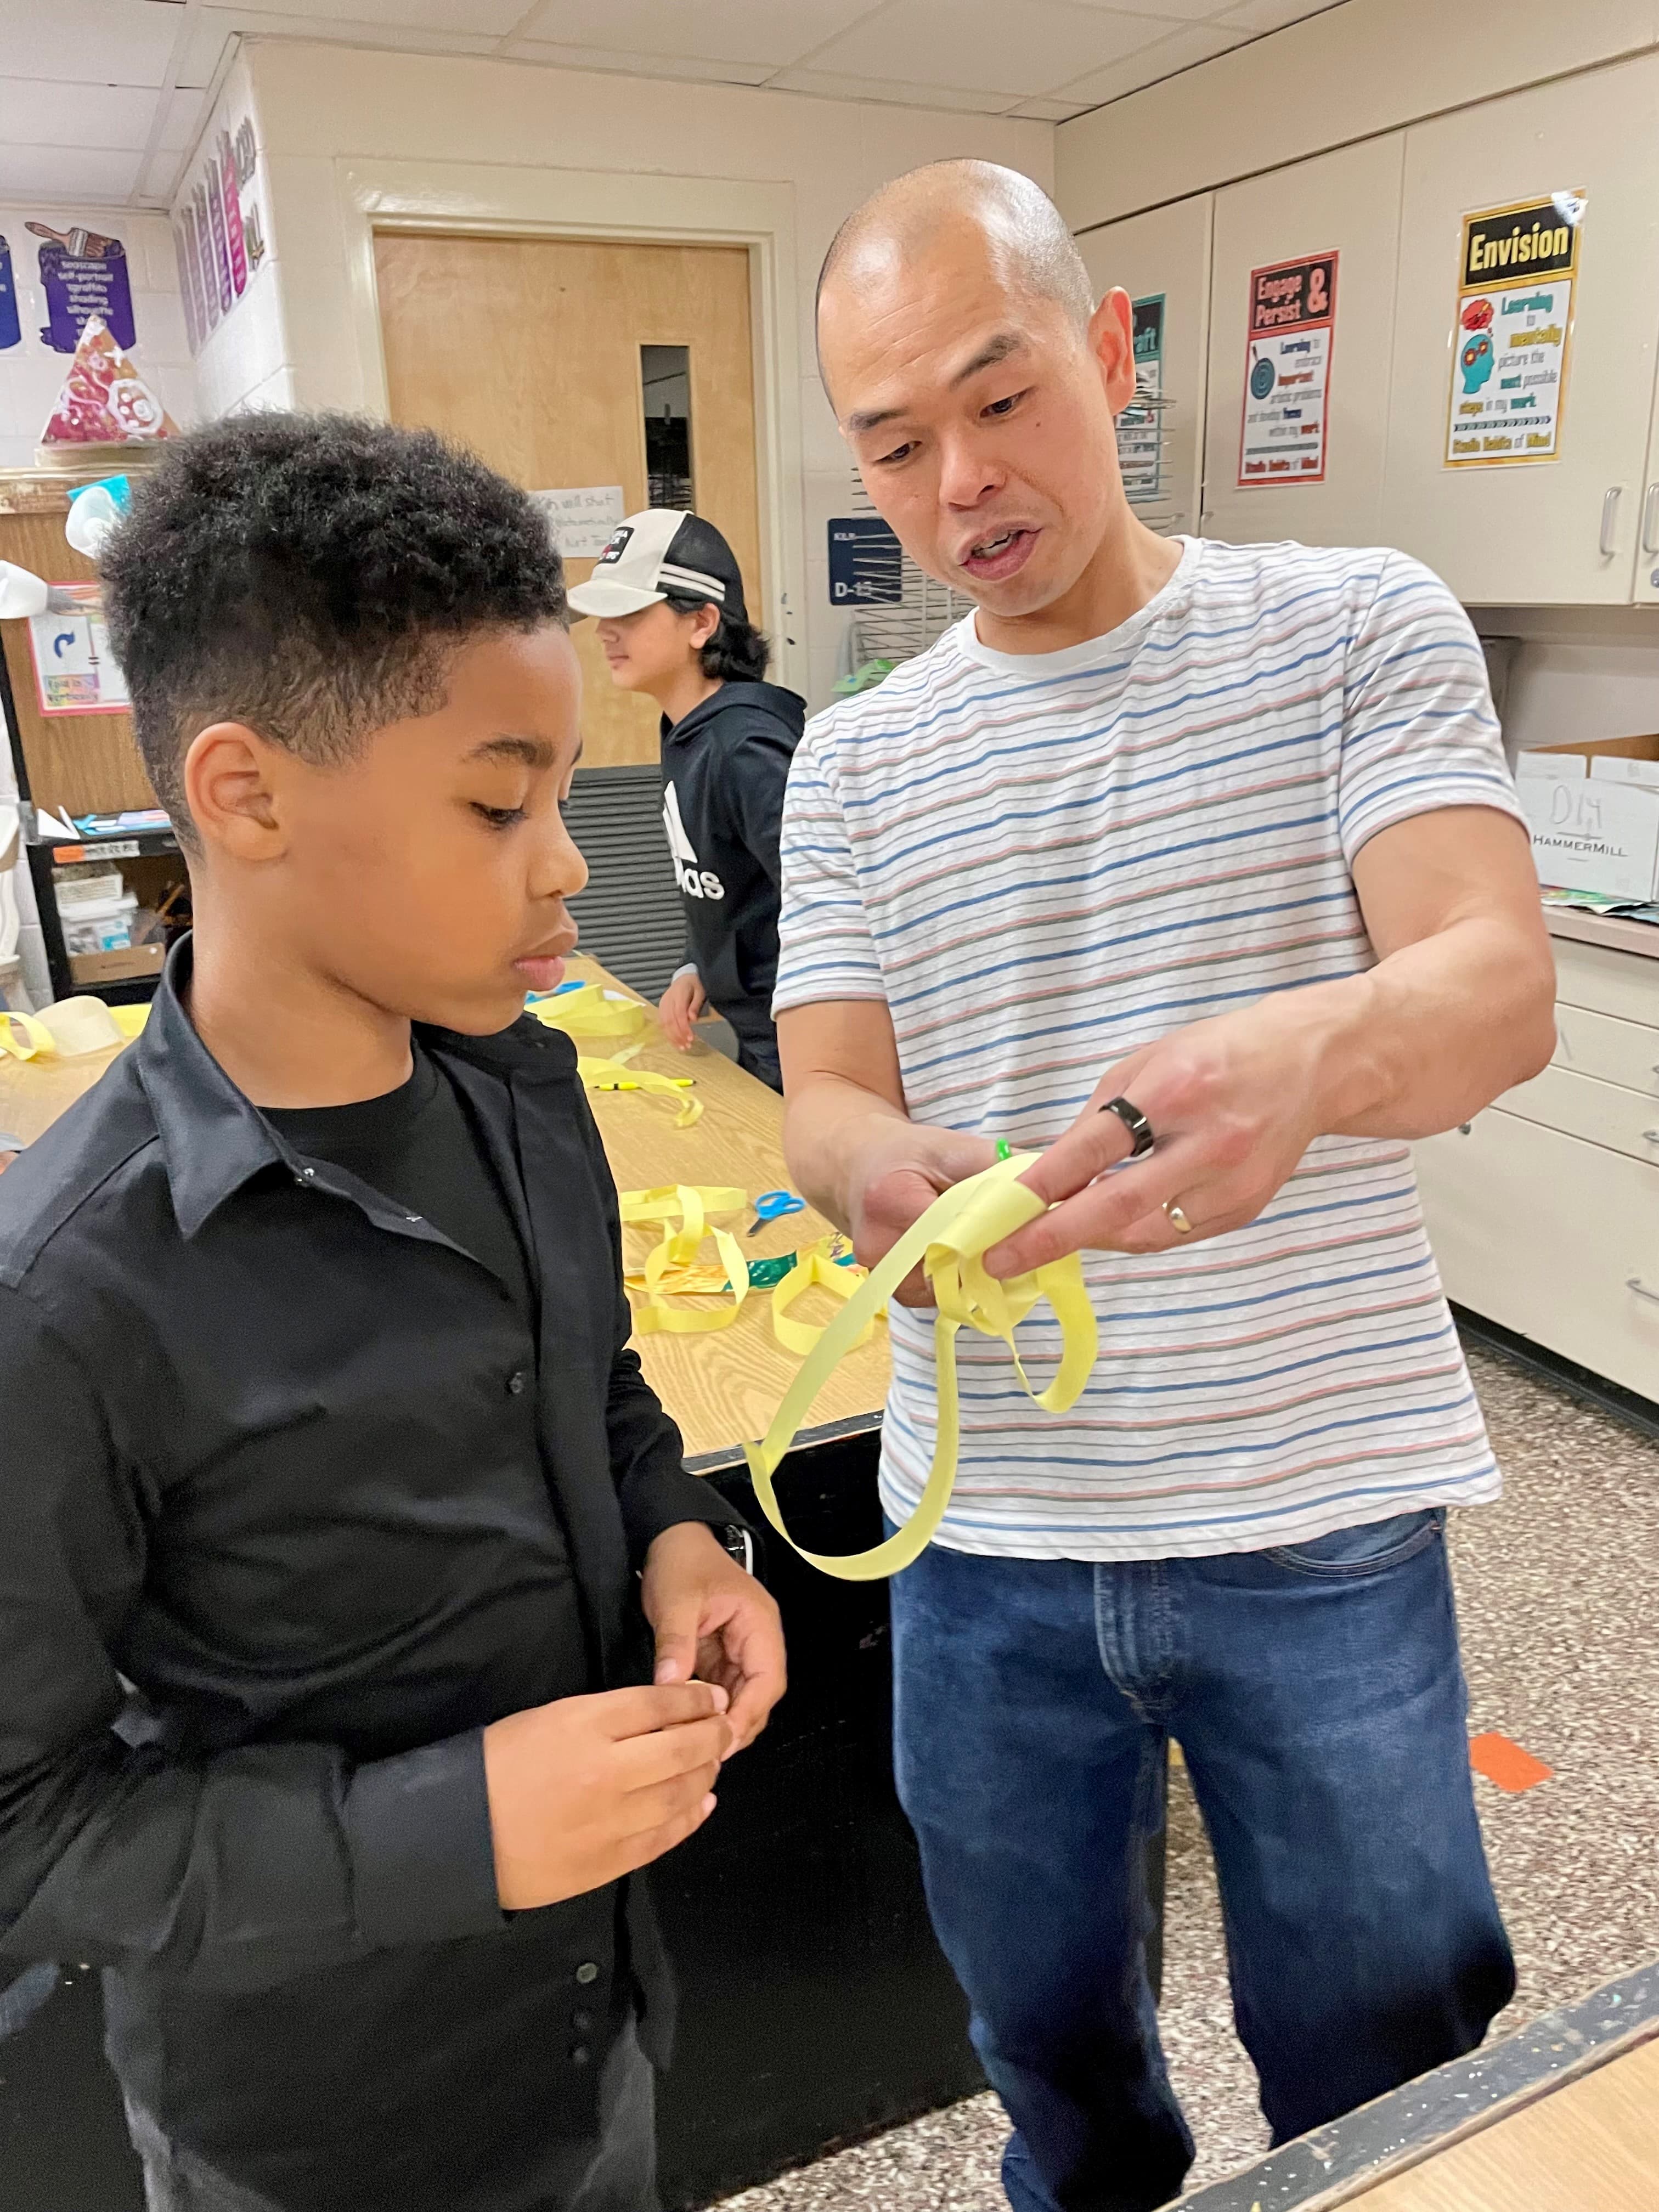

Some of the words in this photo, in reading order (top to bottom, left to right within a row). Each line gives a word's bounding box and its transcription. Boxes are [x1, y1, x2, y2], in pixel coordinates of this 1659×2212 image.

[1469, 221, 1569, 271] Envision
[1257, 274, 1303, 305] Engage
[1307, 268, 1328, 313] &
[1501, 292, 1554, 315] Learning
[1255, 299, 1301, 328] Persist
[1533, 834, 1629, 857] HAMMERMILL
